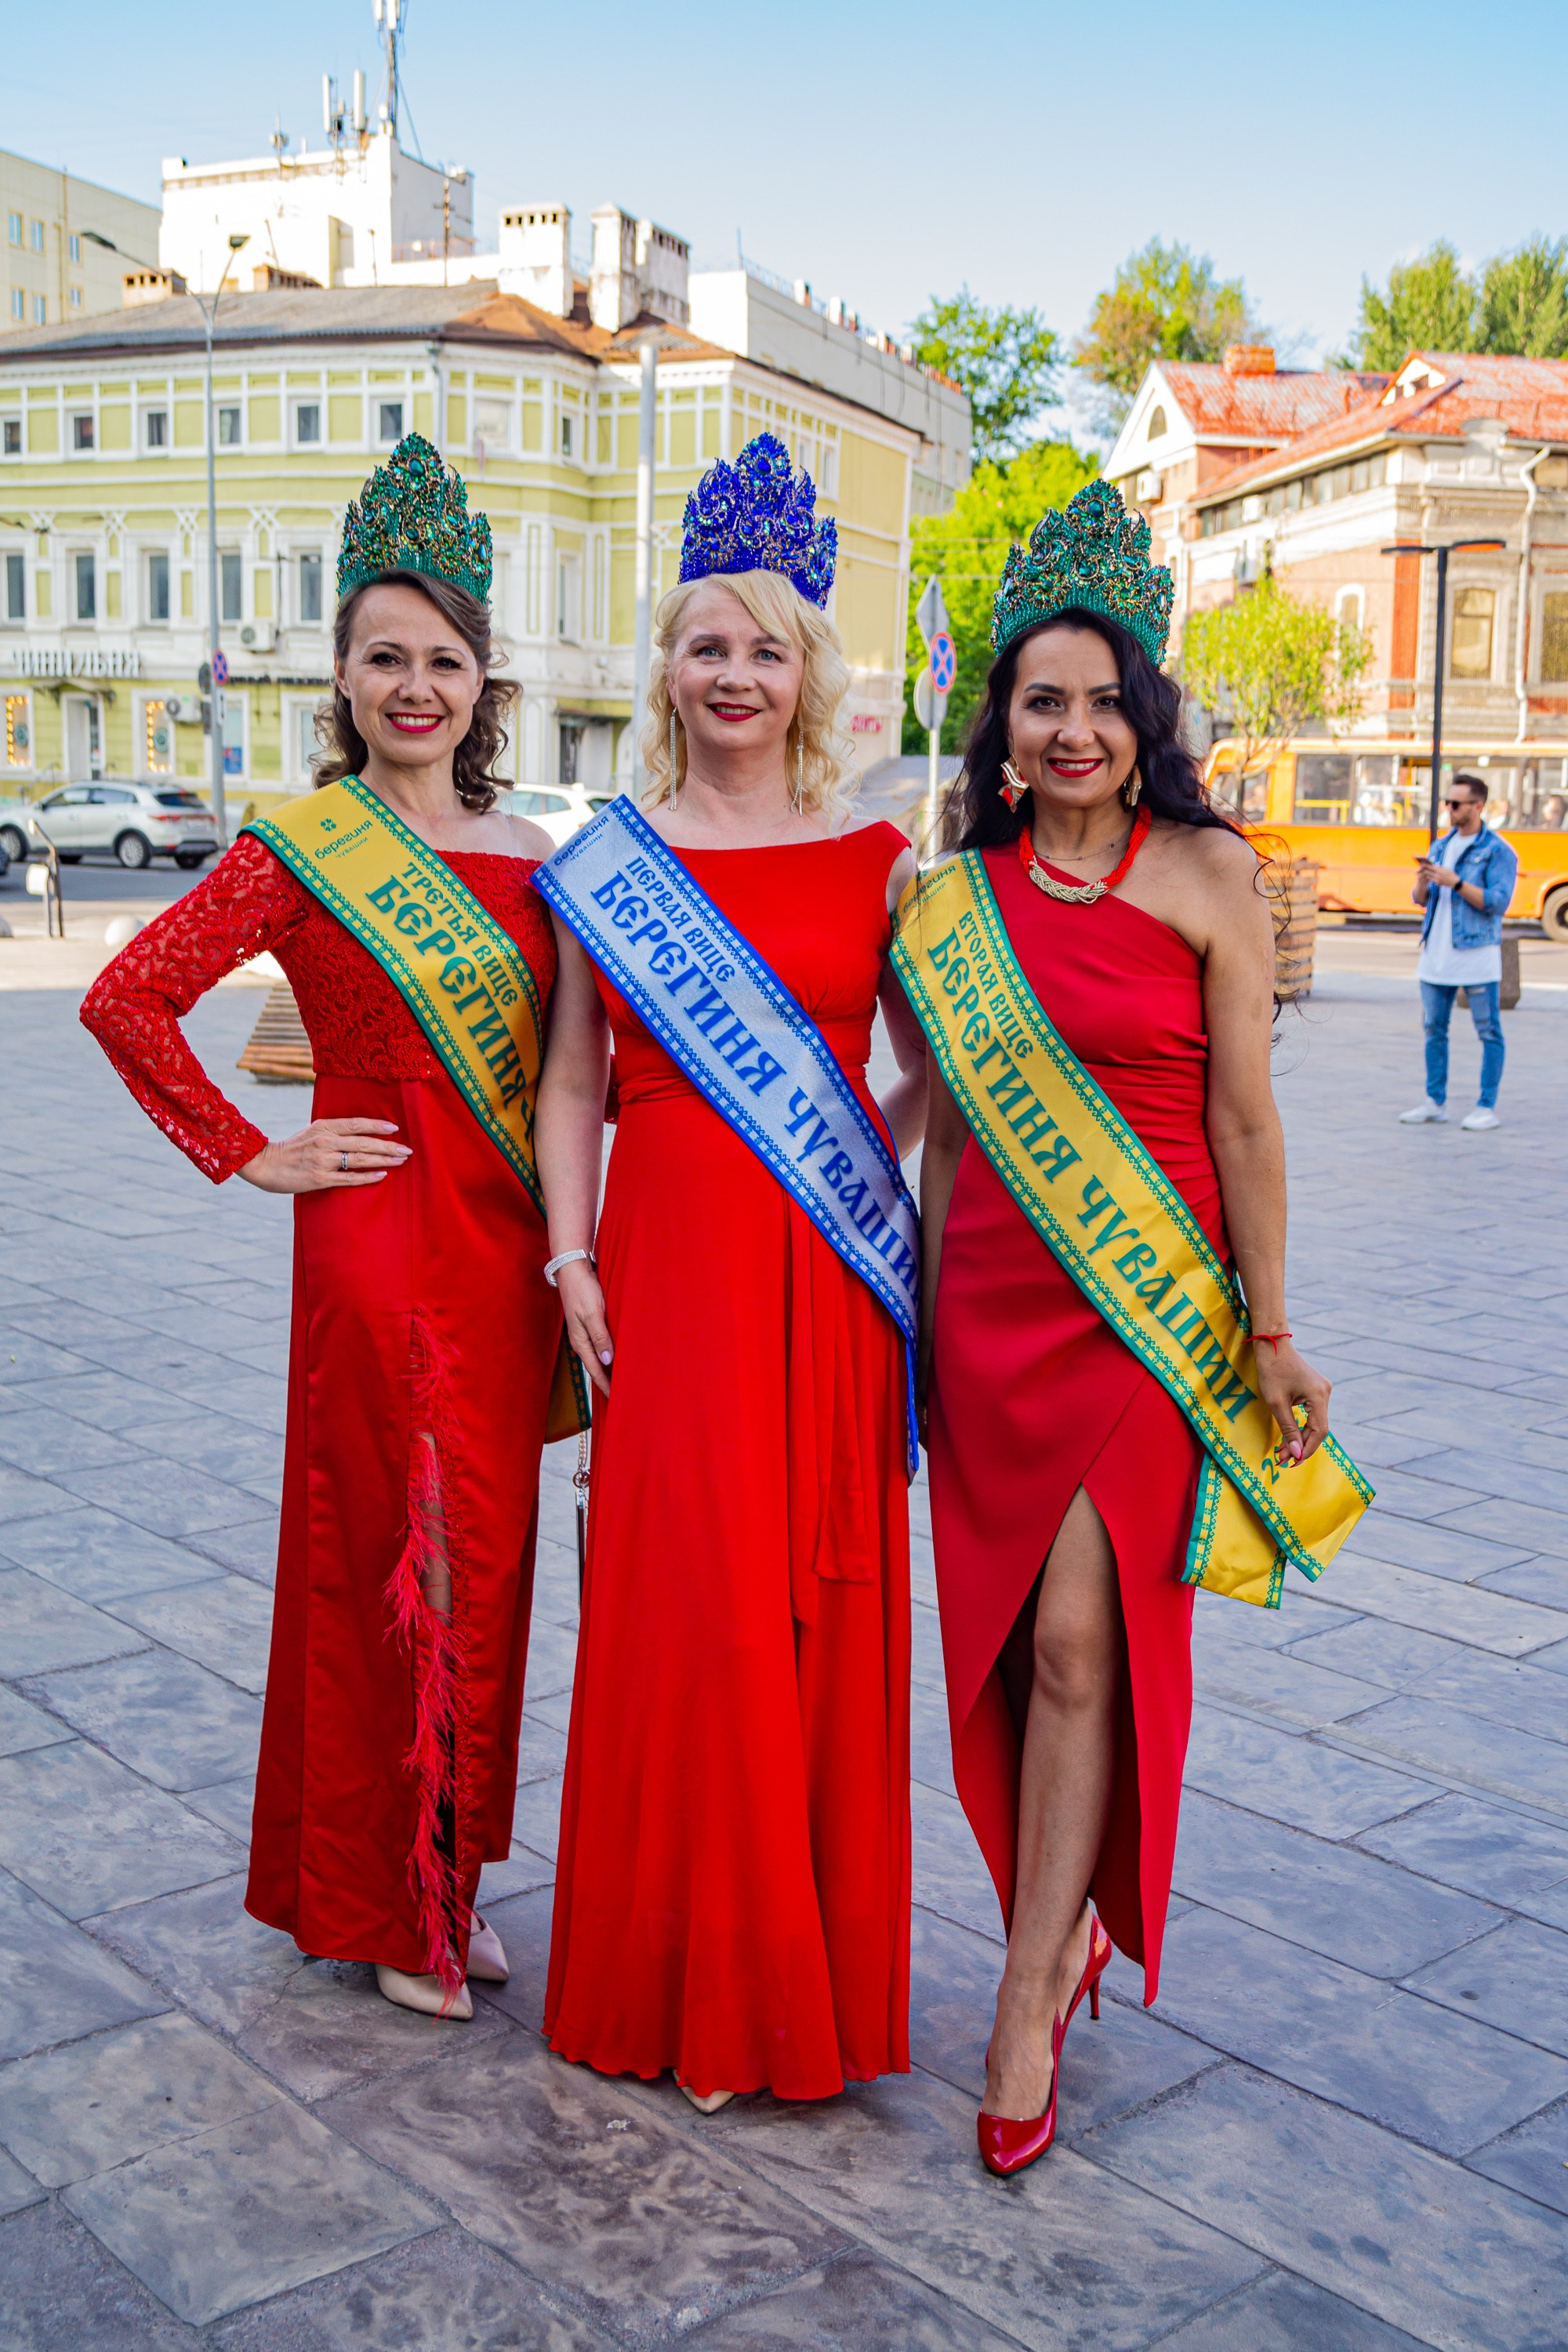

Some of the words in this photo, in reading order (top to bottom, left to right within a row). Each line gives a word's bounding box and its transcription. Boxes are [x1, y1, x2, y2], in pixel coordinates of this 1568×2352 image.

[314, 820, 372, 859] берегиня
[554, 815, 609, 866] берегиня
[401, 862, 480, 945] ТРЕТЬЯ
[472, 945, 518, 1007] ВИЦЕ
[626, 856, 692, 930] ПЕРВАЯ
[683, 927, 735, 982] ВИЦЕ
[959, 910, 999, 994] ВТОРАЯ
[989, 993, 1033, 1059] ВИЦЕ
[365, 875, 527, 1111] БЕРЕГИНЯ
[590, 870, 787, 1097] БЕРЕГИНЯ
[784, 1086, 921, 1307] ЧУВАШИ
[927, 927, 1083, 1184] БЕРЕГИНЯ
[1076, 1174, 1258, 1423] ЧУВАШИИ
